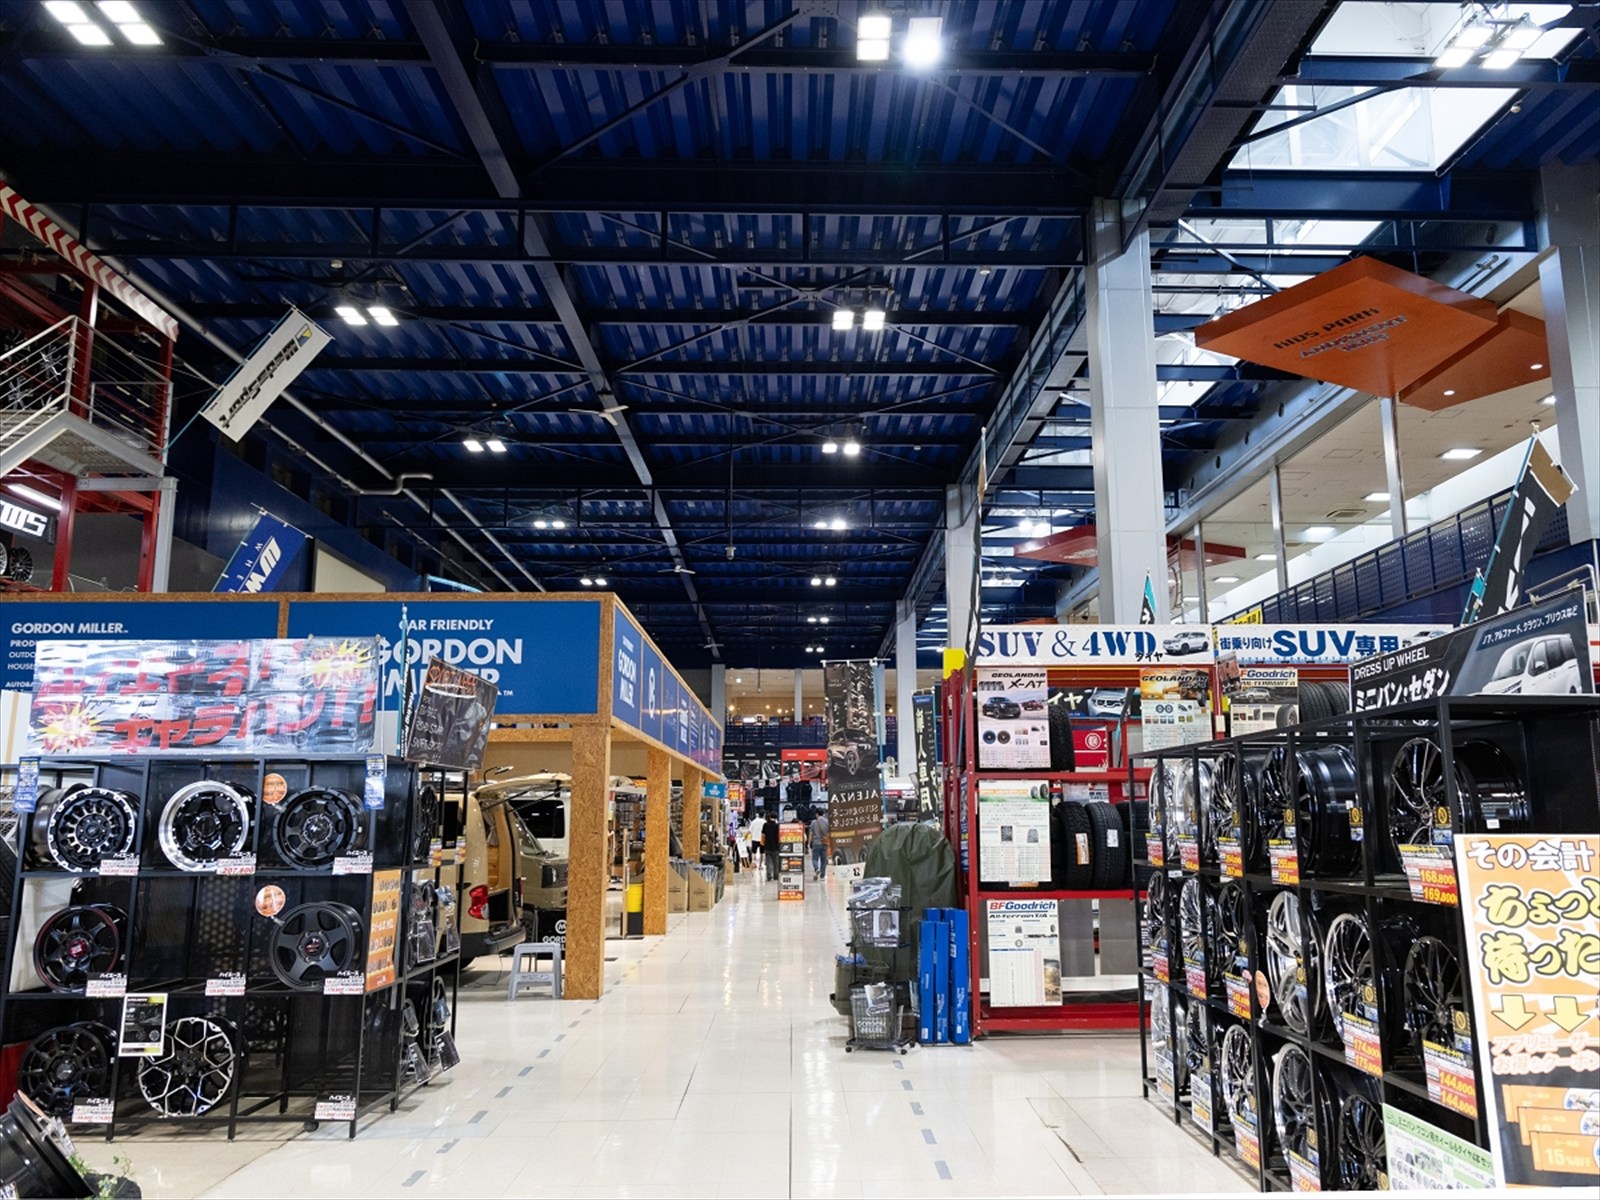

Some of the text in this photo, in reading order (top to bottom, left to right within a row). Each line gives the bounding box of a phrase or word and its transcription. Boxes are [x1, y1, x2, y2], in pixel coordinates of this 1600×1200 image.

[0, 499, 48, 537] WS
[11, 622, 123, 634] GORDON MILLER
[430, 619, 494, 631] FRIENDLY
[10, 640, 37, 648] PROD
[976, 630, 1157, 658] SUV & 4WD
[1135, 652, 1164, 662] タイヤ
[1354, 647, 1430, 681] DRESS UP WHEEL
[1240, 669, 1296, 678] FGoodrich
[1008, 678, 1046, 689] X-AT
[1467, 839, 1595, 872] その会計
[989, 901, 1056, 910] BFGoodrich
[1481, 929, 1599, 984] 待った
